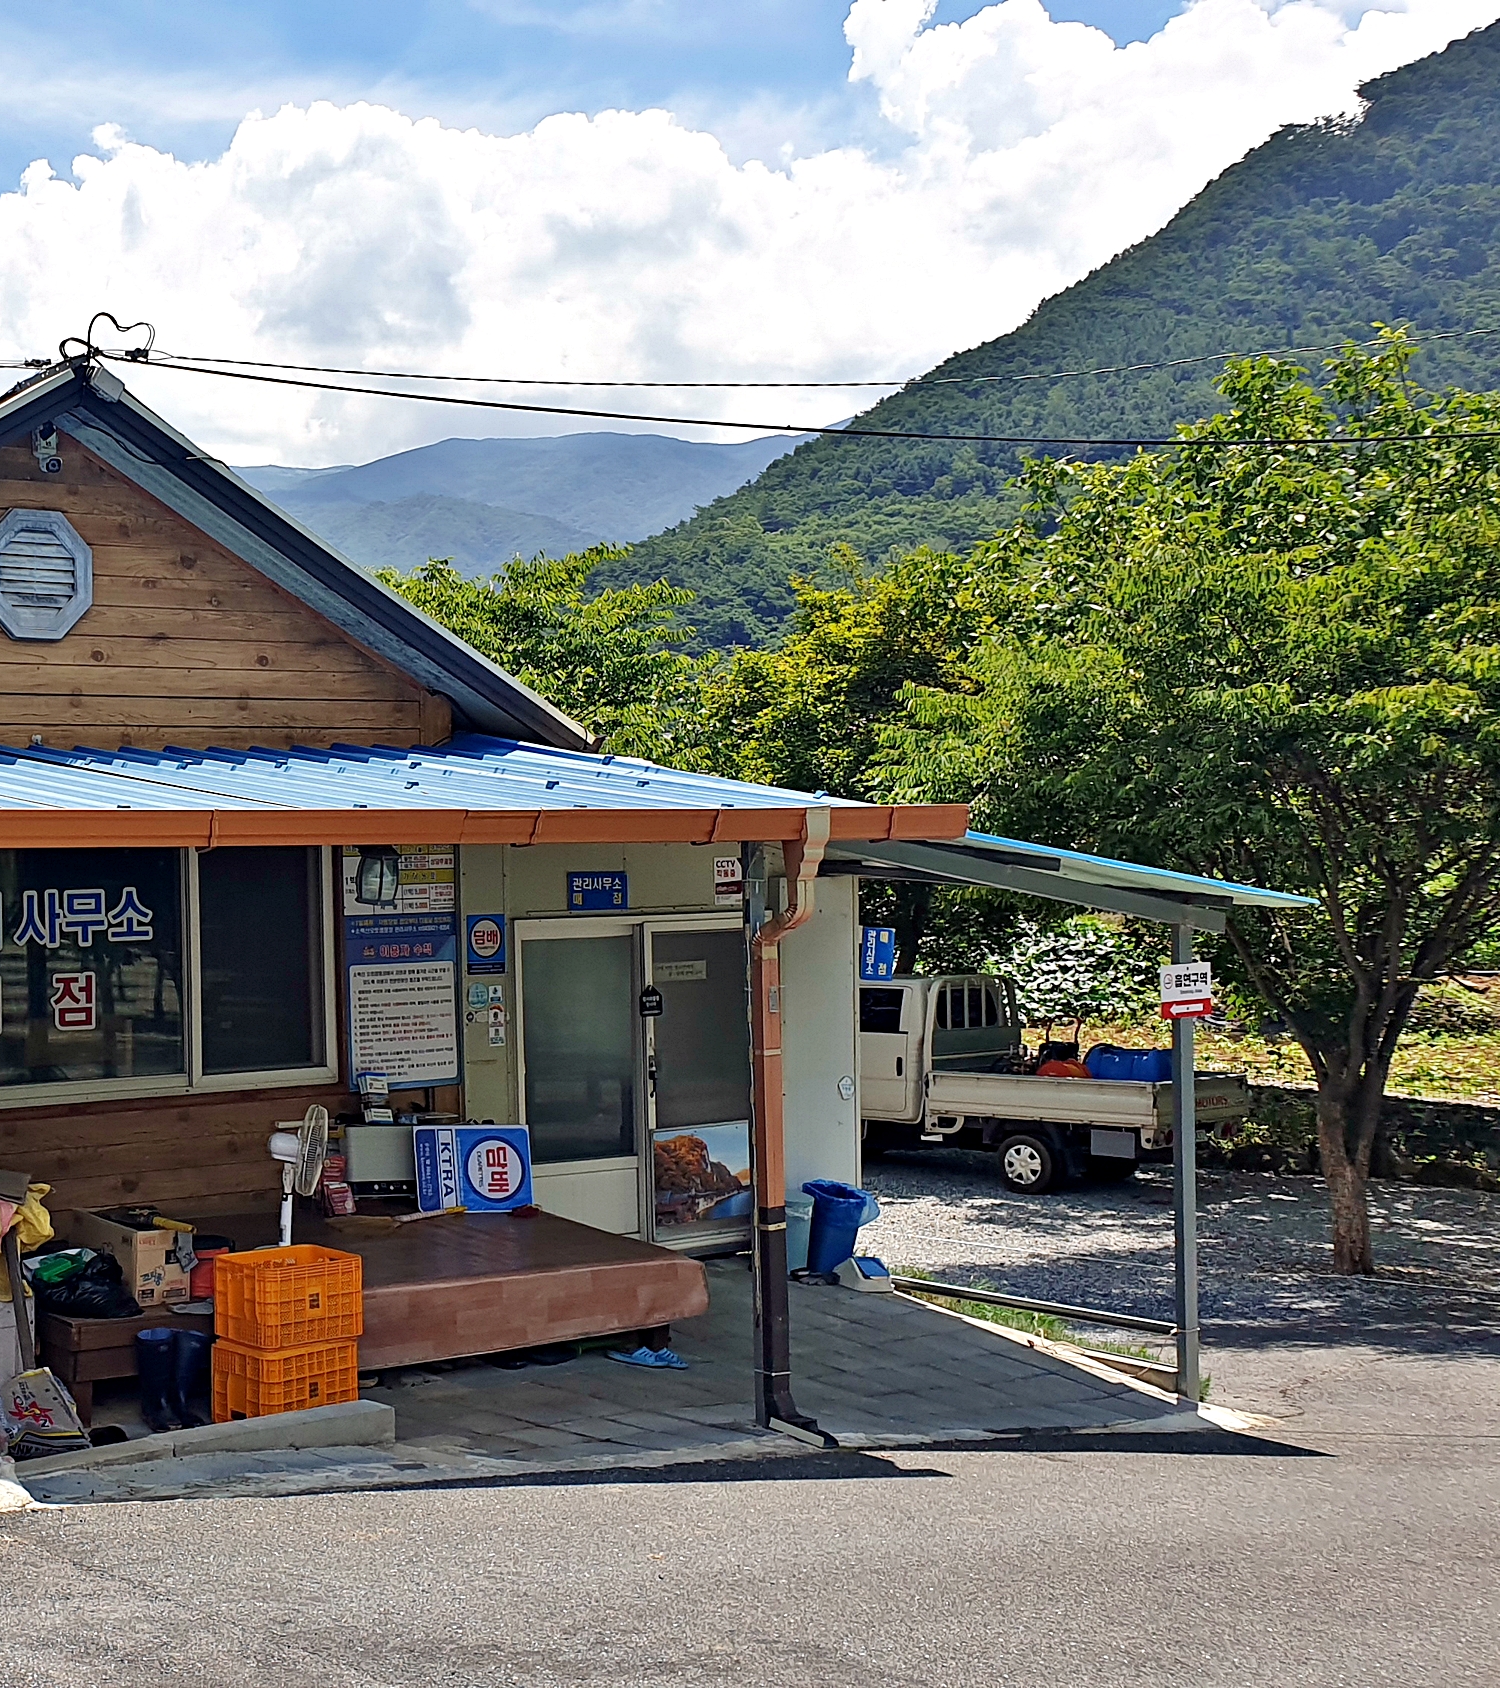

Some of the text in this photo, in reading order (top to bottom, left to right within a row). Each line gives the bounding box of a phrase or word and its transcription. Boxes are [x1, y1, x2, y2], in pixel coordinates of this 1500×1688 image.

[716, 860, 736, 868] CCTV
[572, 878, 622, 890] 관리사무소
[13, 886, 154, 949] 사무소
[474, 930, 498, 946] 담배
[865, 930, 876, 974] 관리사무소
[1174, 972, 1208, 988] 흡연구역
[440, 1142, 454, 1198] KTRA
[486, 1146, 510, 1194] 담배
